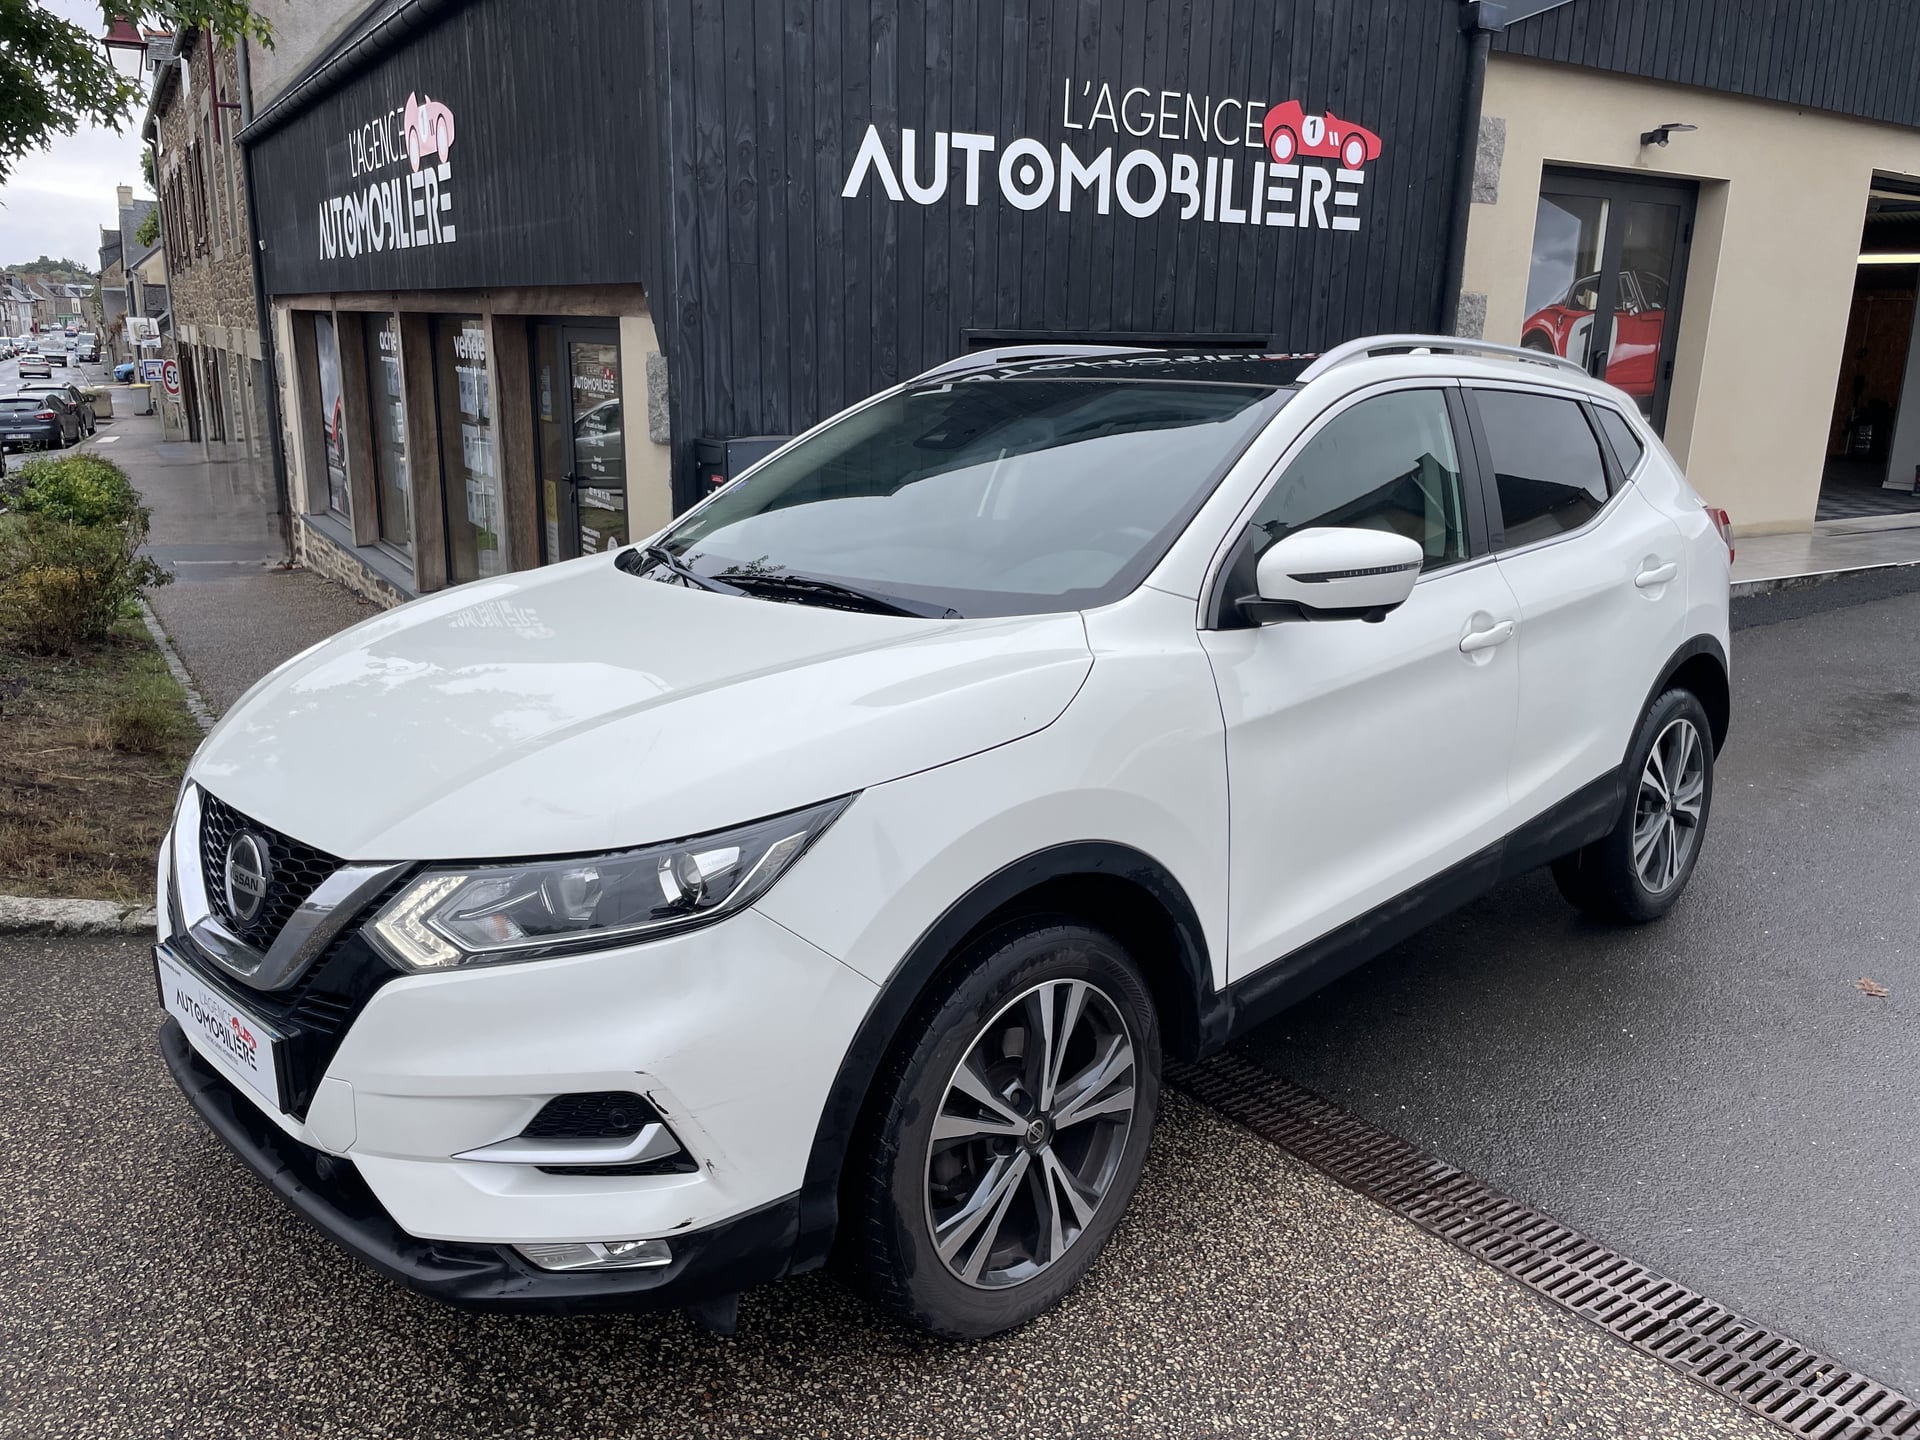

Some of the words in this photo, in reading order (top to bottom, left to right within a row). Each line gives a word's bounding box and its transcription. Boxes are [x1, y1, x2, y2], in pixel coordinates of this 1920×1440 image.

[348, 107, 408, 178] L'AGENCE
[1063, 78, 1266, 148] L'AGENCE
[1309, 119, 1317, 139] 1
[319, 161, 456, 260] AUTOMOBILIERE
[841, 124, 1364, 231] AUTOMOBILIERE
[380, 320, 397, 351] ache
[453, 323, 485, 360] vende
[176, 988, 257, 1072] AUTOMOBILIERE
